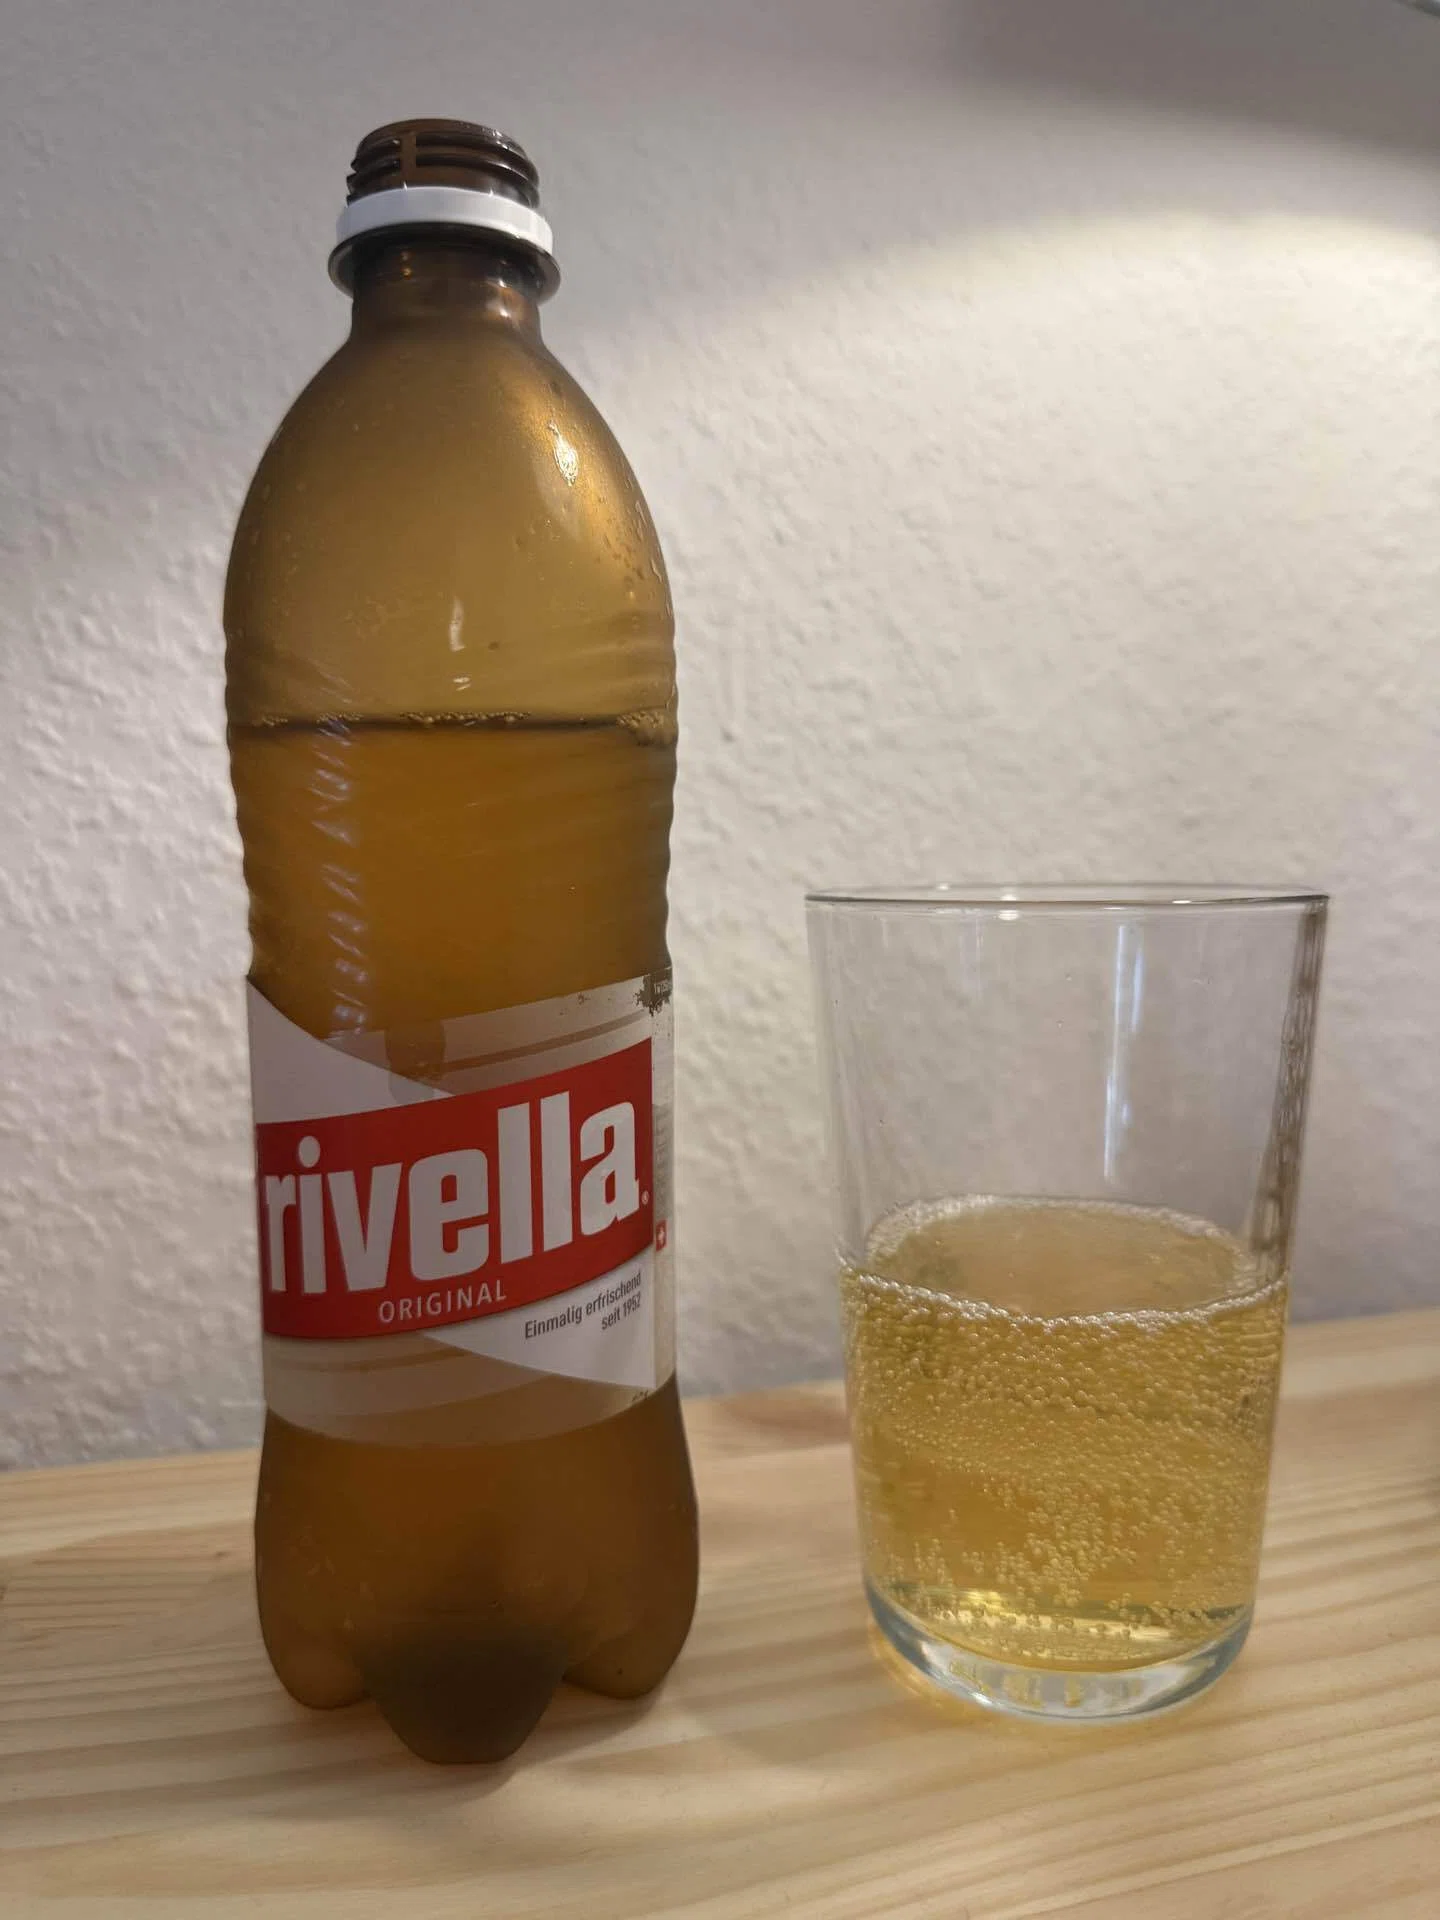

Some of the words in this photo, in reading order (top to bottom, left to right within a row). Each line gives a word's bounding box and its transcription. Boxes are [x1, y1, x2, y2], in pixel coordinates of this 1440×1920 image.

[265, 1091, 640, 1294] rivella
[378, 1279, 507, 1323] ORIGINAL
[525, 1305, 583, 1340] Einmalig
[586, 1269, 642, 1317] erfrischend
[601, 1307, 621, 1331] seit
[622, 1291, 642, 1318] 1952
